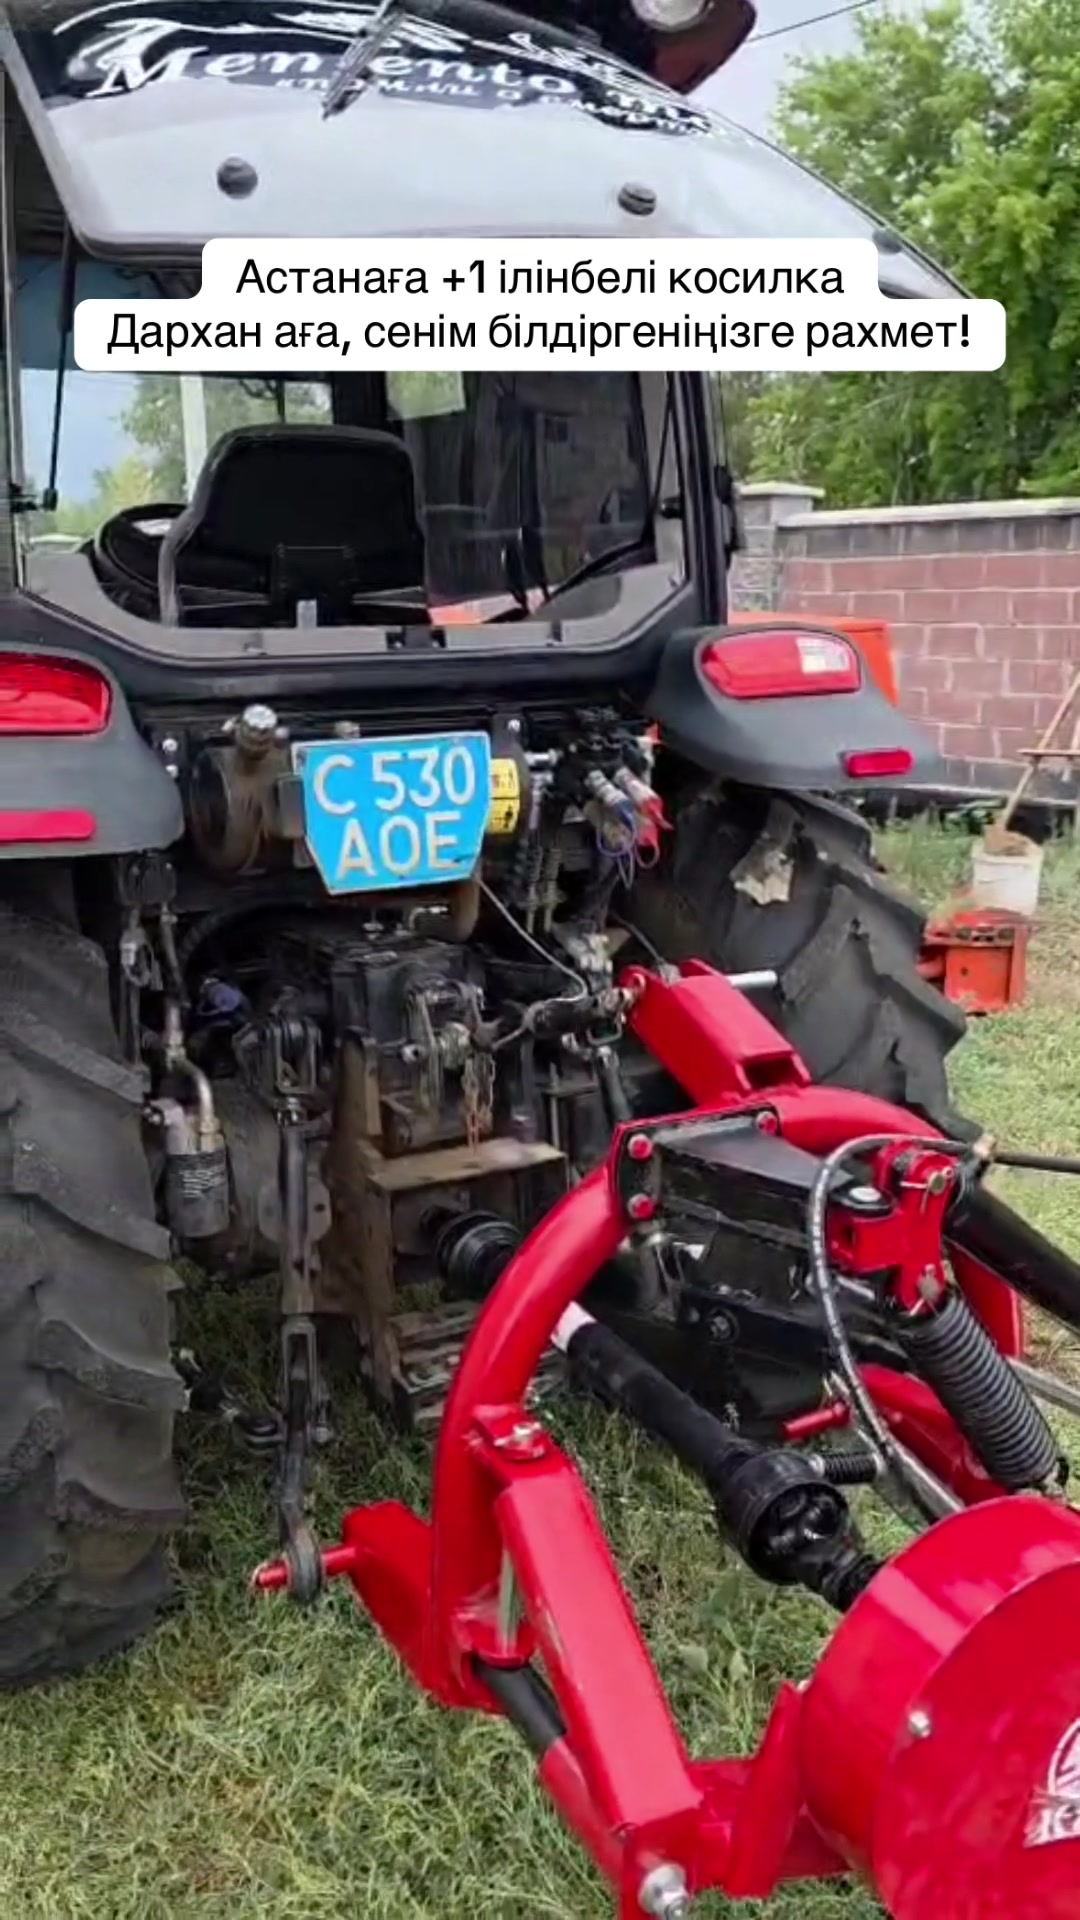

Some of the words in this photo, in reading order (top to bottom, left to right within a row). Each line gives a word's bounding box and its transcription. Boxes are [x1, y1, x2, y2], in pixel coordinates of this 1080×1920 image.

[313, 754, 357, 815] C
[372, 745, 475, 811] 530
[337, 811, 461, 880] AOE
